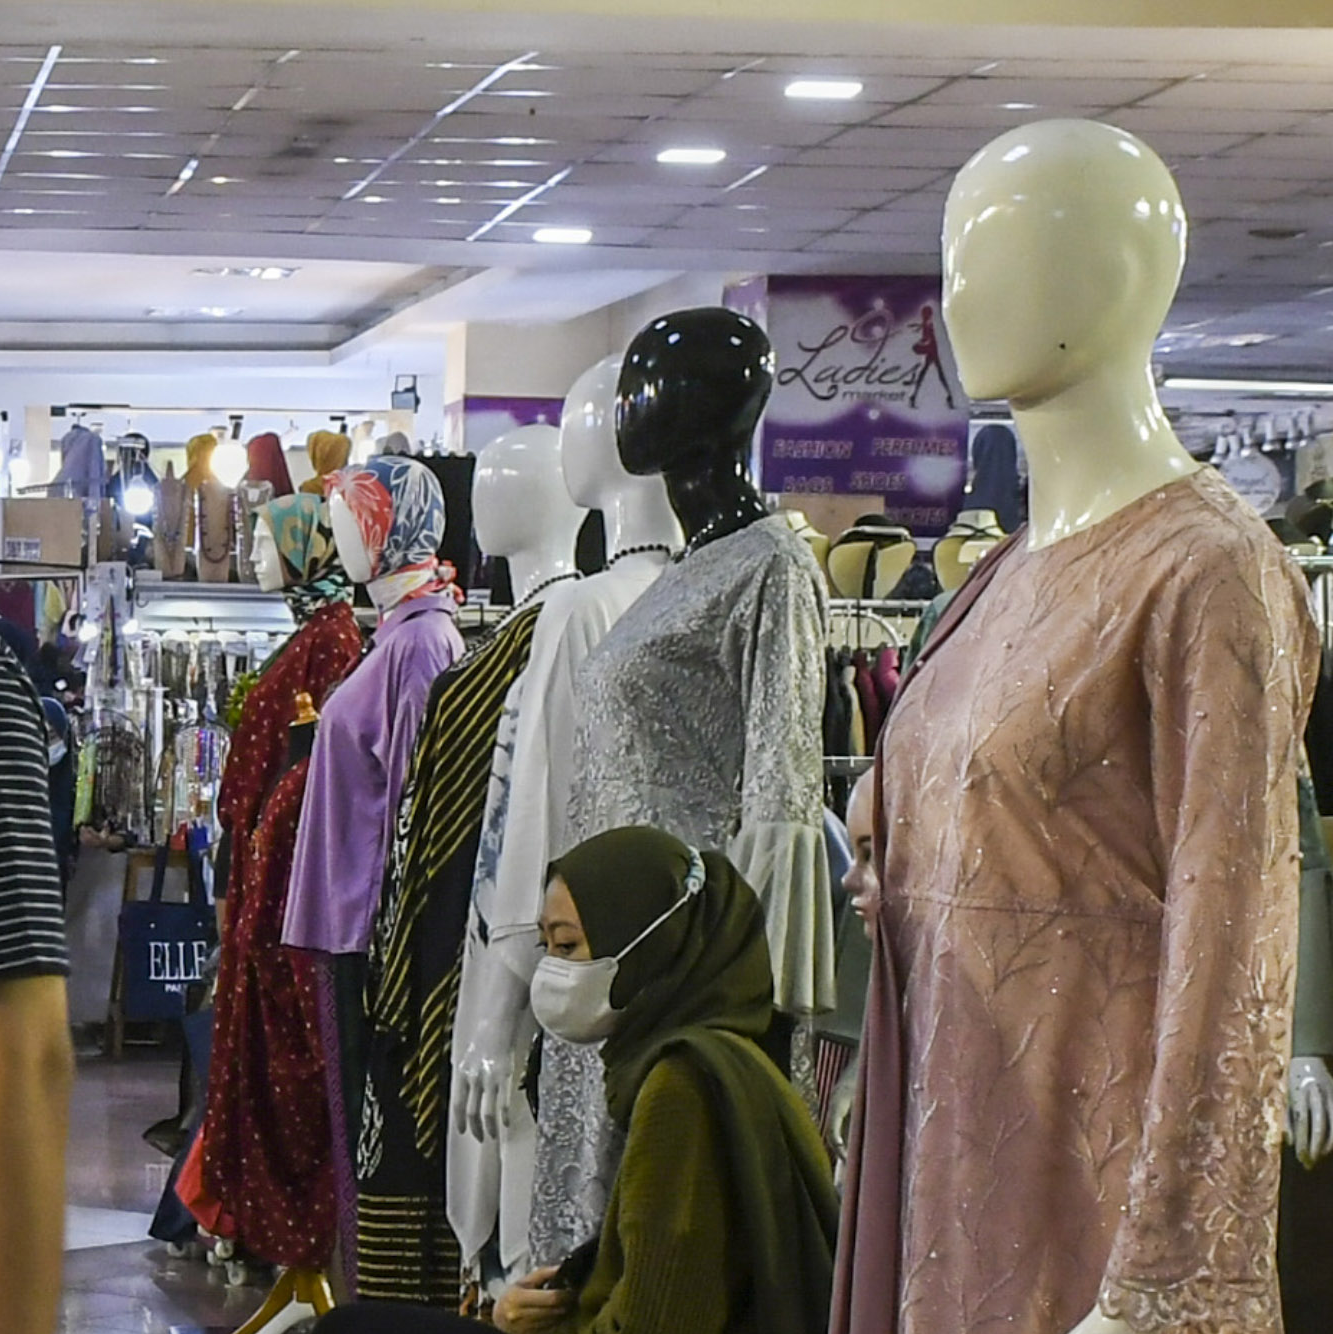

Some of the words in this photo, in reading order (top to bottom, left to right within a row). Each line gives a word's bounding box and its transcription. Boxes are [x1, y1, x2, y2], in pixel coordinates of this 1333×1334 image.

[778, 306, 921, 400] Ladies
[842, 387, 907, 400] market
[773, 438, 854, 460] FASHION
[872, 437, 958, 457] PERFUMES
[850, 470, 906, 491] SHOES
[149, 940, 207, 980] ELLE
